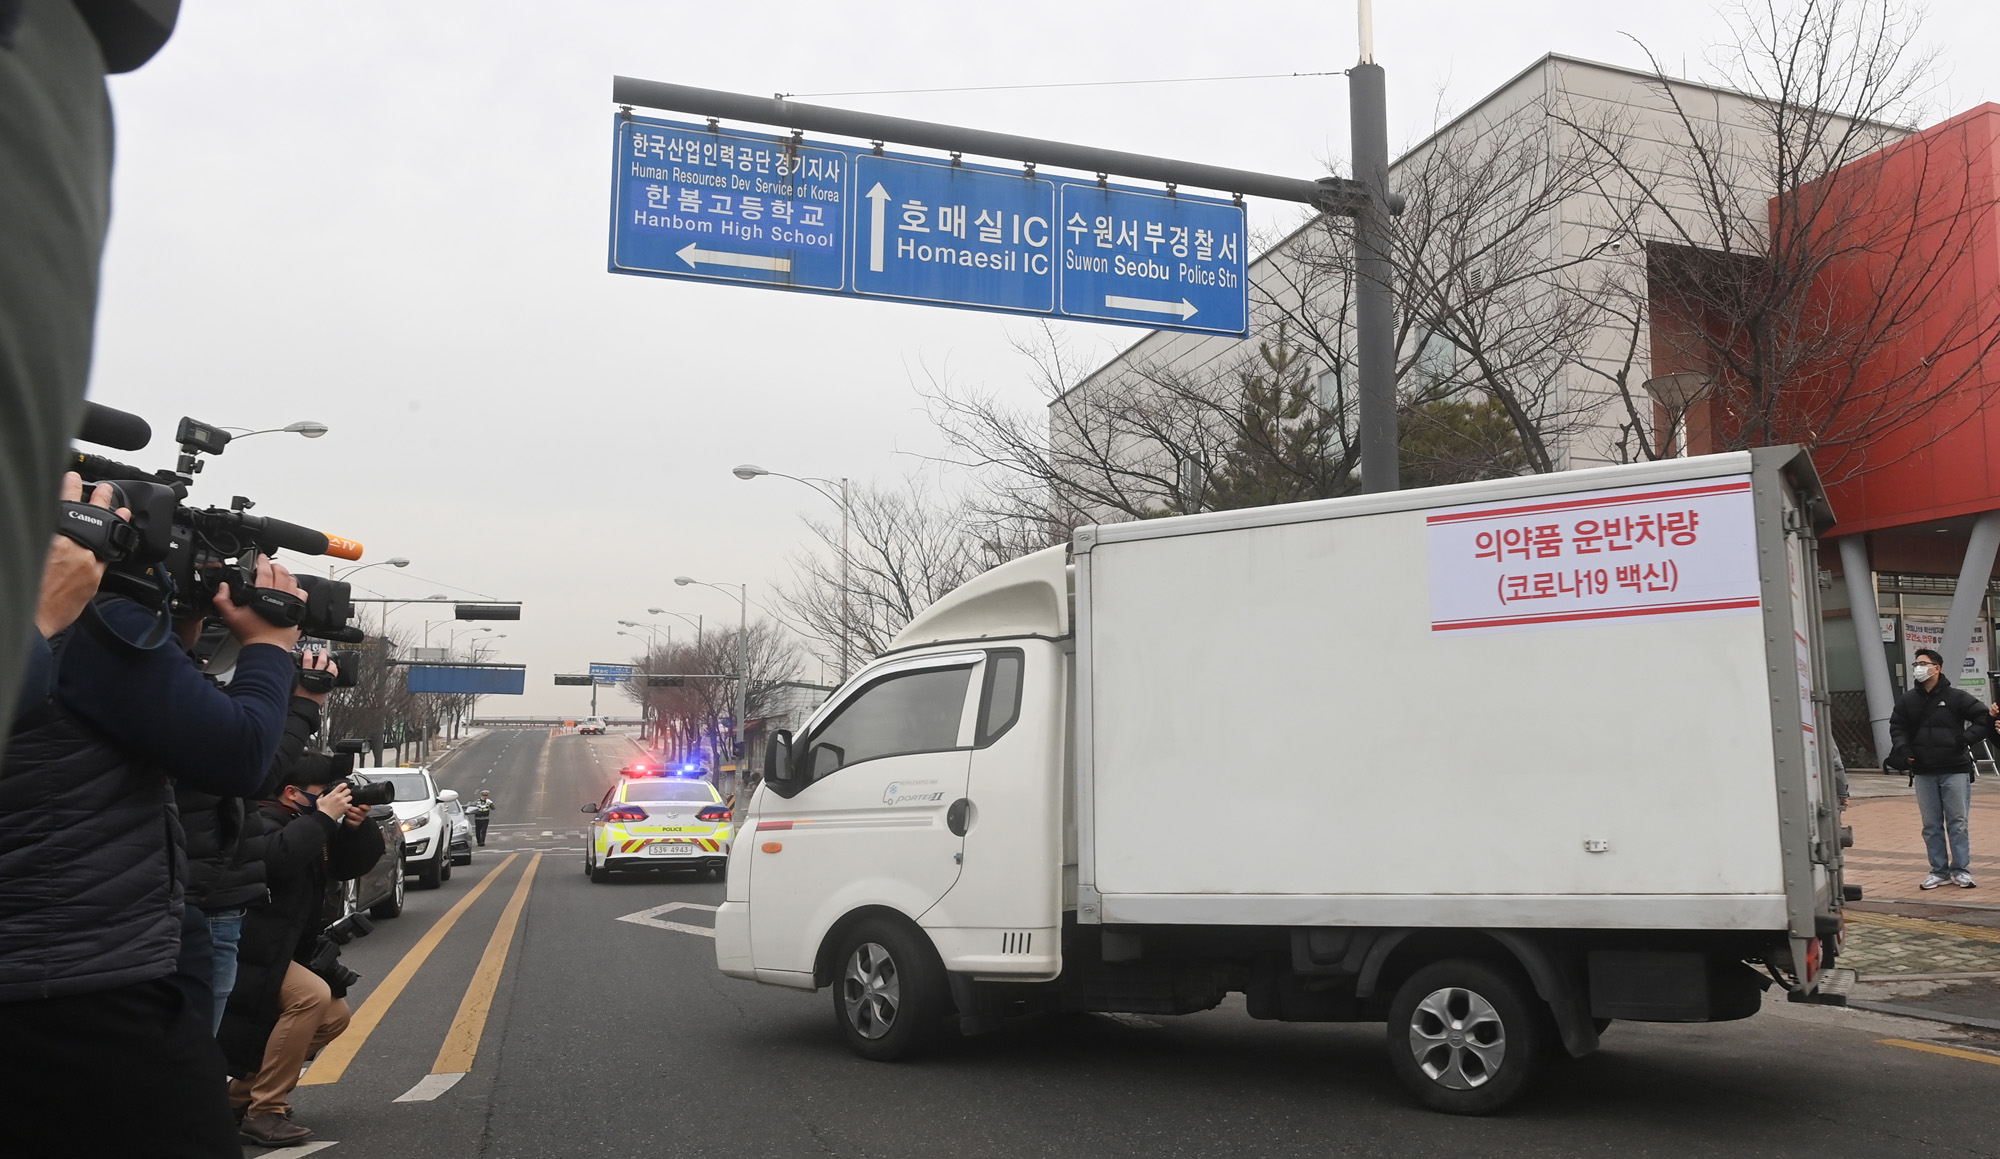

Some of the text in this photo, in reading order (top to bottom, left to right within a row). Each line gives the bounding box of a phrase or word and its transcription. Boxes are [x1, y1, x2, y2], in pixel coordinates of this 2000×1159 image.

[633, 132, 840, 183] 한국산업인력공단 경기지사
[631, 161, 840, 202] Human Resources Dev Service of Korea
[645, 183, 824, 227] 한봄고등학교
[634, 210, 833, 247] Hanbom High School
[1066, 212, 1238, 265] 수원서부경찰서
[897, 237, 1049, 276] Homaesil IC
[1066, 248, 1238, 289] Suwon Seobu Police Stn
[68, 510, 103, 526] Canon
[1474, 510, 1699, 562] 의약품 운반차량
[262, 595, 285, 607] Canon
[1498, 559, 1679, 605] (코로나19 백신)
